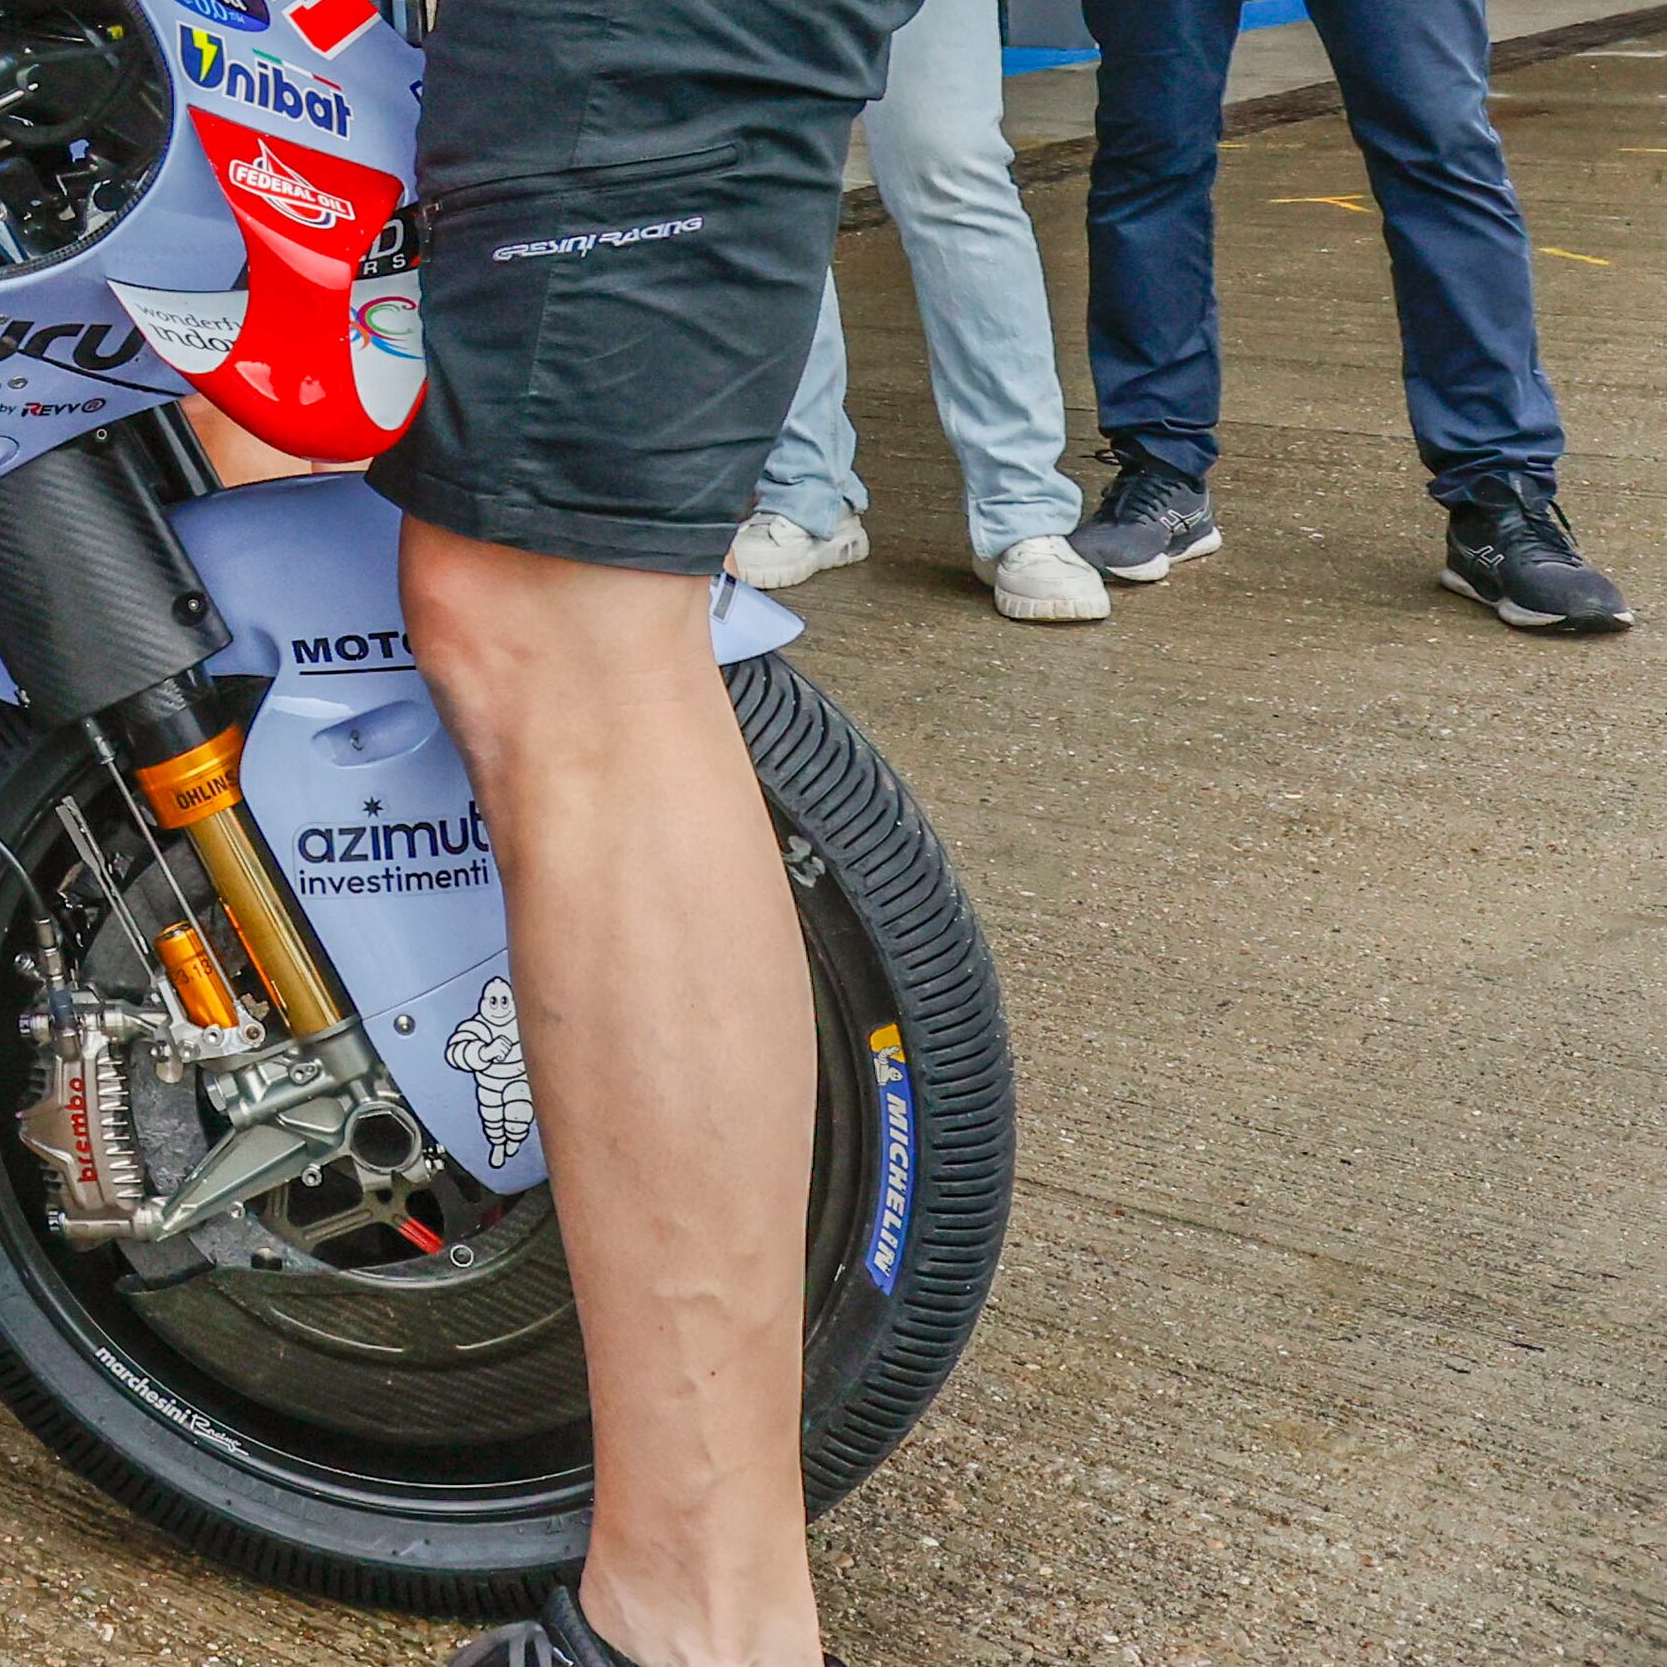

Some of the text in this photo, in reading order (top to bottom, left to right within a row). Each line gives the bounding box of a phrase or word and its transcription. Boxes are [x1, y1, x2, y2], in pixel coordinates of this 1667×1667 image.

[178, 22, 353, 140] Unibat
[235, 165, 347, 214] FEDERAL OIL
[598, 216, 704, 246] RACING
[297, 798, 490, 865] azimut
[298, 857, 491, 897] investimenti
[68, 1075, 100, 1185] brembo
[872, 1092, 911, 1277] MICHELIN
[94, 1345, 250, 1457] marchesini Racing
